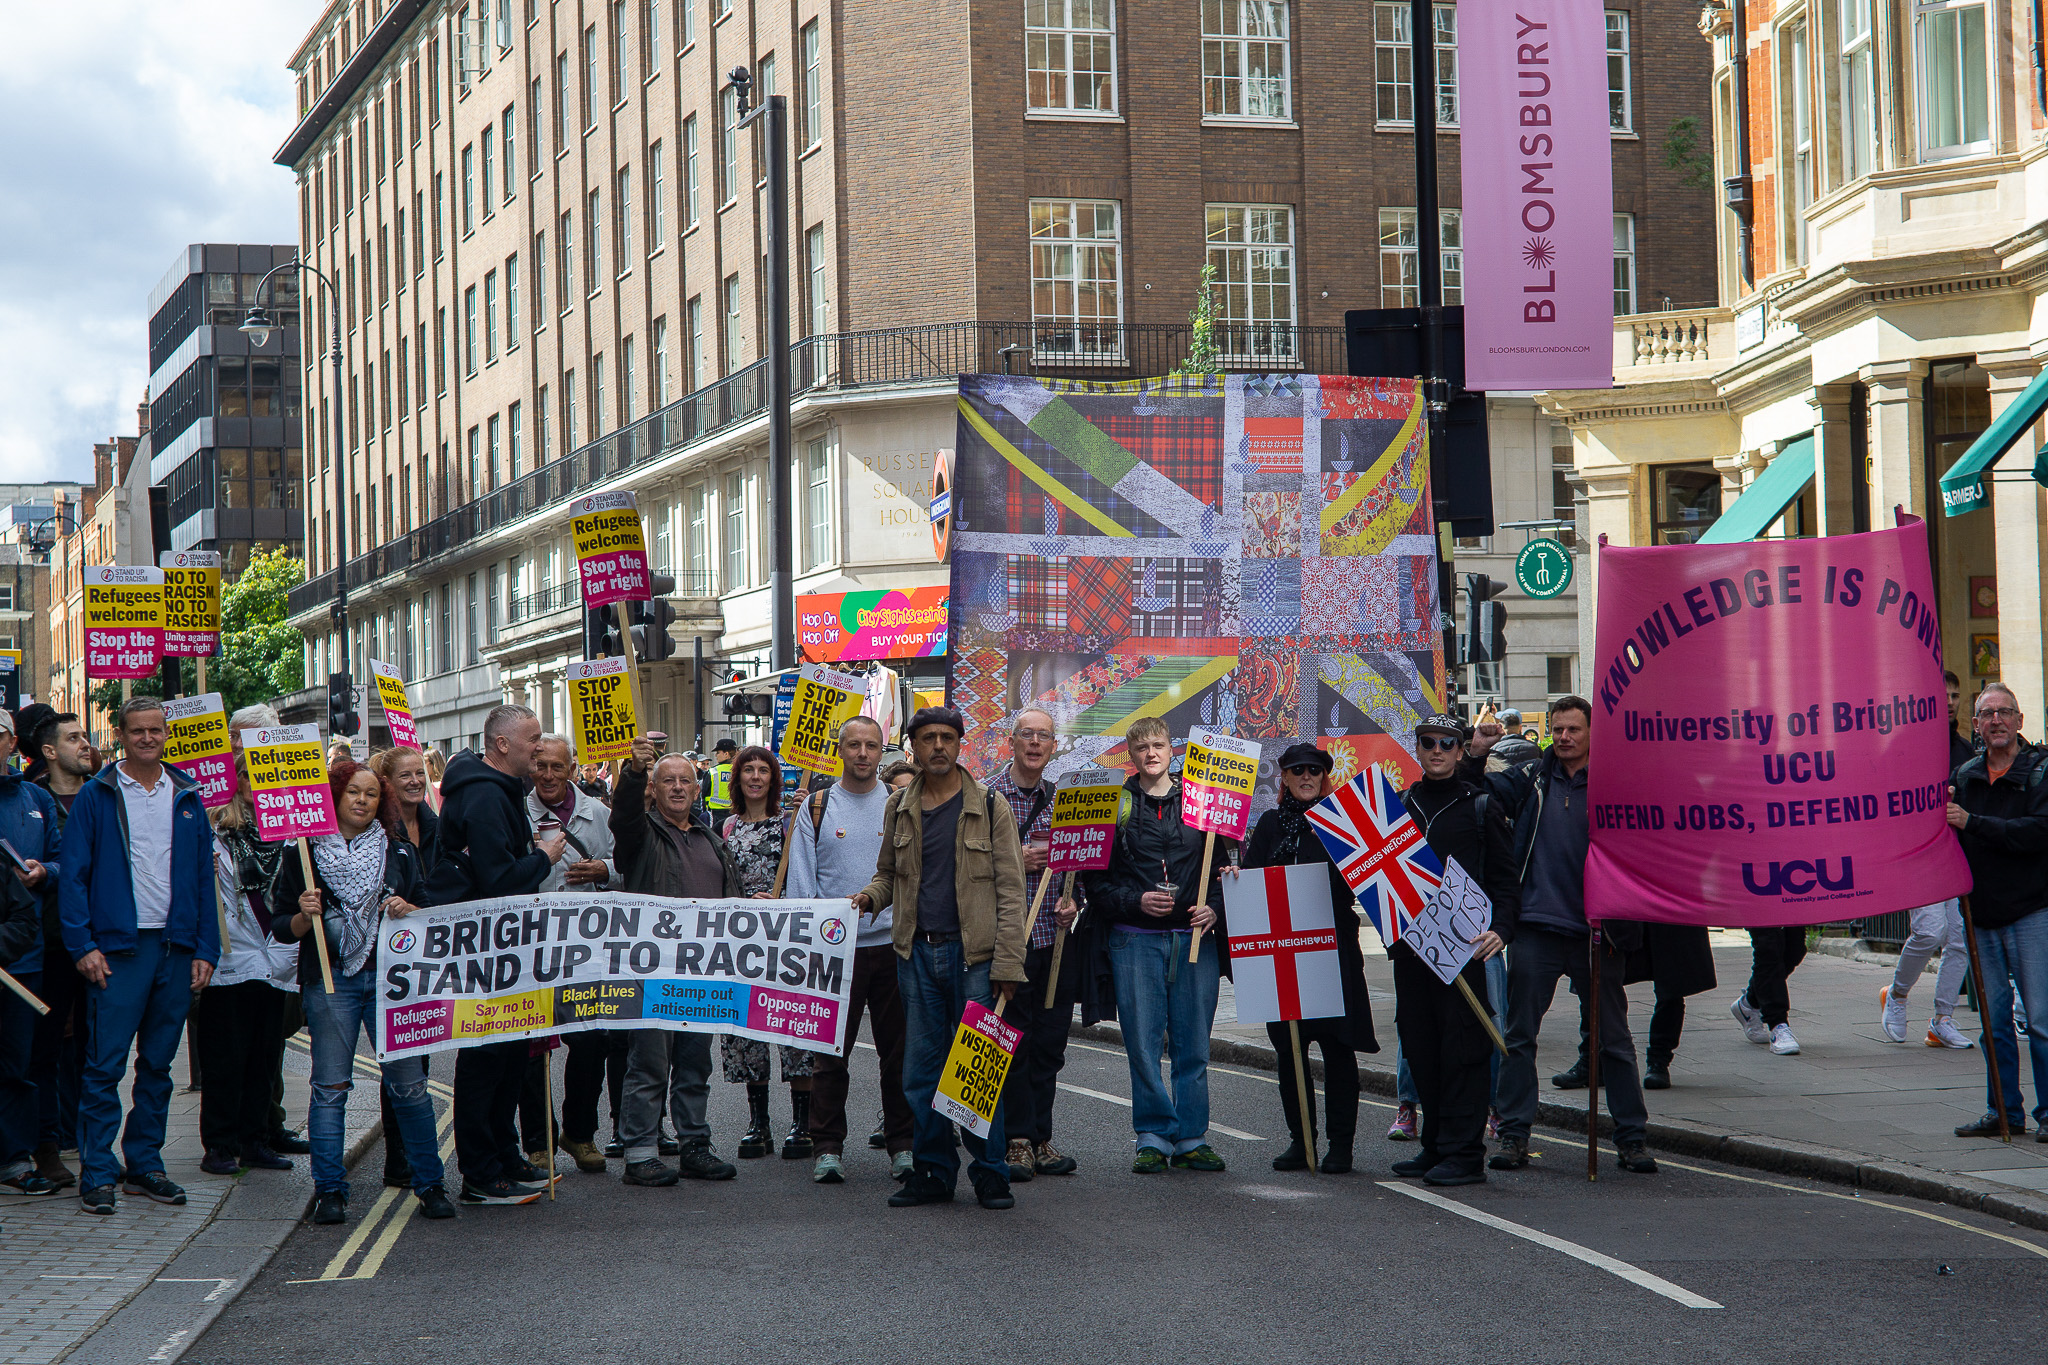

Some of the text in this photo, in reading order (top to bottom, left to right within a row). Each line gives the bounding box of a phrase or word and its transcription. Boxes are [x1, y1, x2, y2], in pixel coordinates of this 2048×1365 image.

[1489, 345, 1590, 354] BLOOMSBURYLONDON.COM
[863, 451, 937, 473] RUSSE
[1943, 482, 1984, 508] FARMER J
[574, 515, 640, 536] Refugees
[880, 506, 930, 526] HOUS
[578, 533, 640, 553] welcome
[582, 554, 642, 577] Stop the
[124, 575, 148, 583] RACISM
[164, 571, 206, 584] NO TO
[586, 572, 644, 596] far right
[89, 588, 161, 607] Refugees
[164, 585, 216, 600] RACISM,
[89, 606, 158, 621] welcome
[165, 600, 207, 613] NO TO
[165, 614, 218, 628] FASCISM
[802, 611, 837, 628] Hop On
[857, 606, 948, 628] City Sightseeing
[89, 631, 155, 650] Stop the
[165, 632, 214, 644] Unite against
[802, 628, 840, 646] Hop Off
[871, 632, 949, 646] BUY YOUR TICK
[1600, 565, 1802, 717] KNOWLEDGE
[1824, 565, 1864, 607] IS
[165, 643, 211, 654] the far right
[89, 650, 154, 669] far right
[577, 676, 621, 696] STOP
[804, 682, 847, 707] STOP
[580, 694, 613, 712] THE
[802, 698, 832, 721] THE
[582, 711, 615, 729] FAR
[796, 714, 826, 737] FAR
[1624, 694, 1937, 746] University of Brighton
[271, 728, 290, 736] STAND
[271, 734, 304, 743] TO RACISM
[584, 723, 635, 745] RIGHT
[792, 730, 839, 757] RIGHT
[249, 748, 321, 766] Refugees
[788, 754, 796, 762] No
[797, 757, 835, 773] antisemitism
[790, 746, 837, 765] No Islamophobia
[1189, 745, 1255, 774] Refugees
[199, 760, 226, 777] the
[253, 767, 321, 784] welcome
[1187, 764, 1249, 788] welcome
[1763, 750, 1836, 785] UCU
[257, 789, 323, 811] Stop the
[1058, 790, 1118, 806] Refugees
[1184, 782, 1242, 810] Stop the
[1055, 807, 1112, 822] welcome
[1183, 797, 1239, 827] far right
[1596, 780, 1948, 834] DEFEND JOBS, DEFEND EDUCAT
[260, 807, 326, 829] far right
[1051, 828, 1106, 846] Stop the
[1050, 844, 1103, 863] far right
[1347, 850, 1384, 882] REFUGEES
[481, 906, 505, 917] Brighton
[513, 903, 528, 911] Hove
[528, 901, 549, 909] Stands
[550, 900, 559, 909] Up
[568, 899, 590, 907] Racism
[1405, 858, 1463, 951] DEPORT
[435, 911, 473, 924] sutr_brighton
[422, 905, 814, 959] BRIGHTON & HOVE
[1425, 876, 1488, 980] RACISTS
[1256, 940, 1276, 950] THY
[385, 941, 844, 1001] STAND UP TO RACISM
[562, 985, 635, 1003] Black Lives
[661, 983, 734, 1002] Stamp out
[393, 1006, 447, 1026] Refugees
[475, 998, 535, 1018] Say no to
[575, 1001, 619, 1017] Matter
[652, 1002, 739, 1020] antisemitism
[758, 993, 831, 1019] Oppose the
[460, 1013, 546, 1034] Islamophobia
[766, 1014, 819, 1036] far right
[394, 1024, 445, 1045] welcome
[960, 1029, 1009, 1072] FASCISM
[955, 1060, 999, 1102] RACISM,
[971, 1055, 1004, 1087] NO TO
[960, 1085, 993, 1118] NO TO
